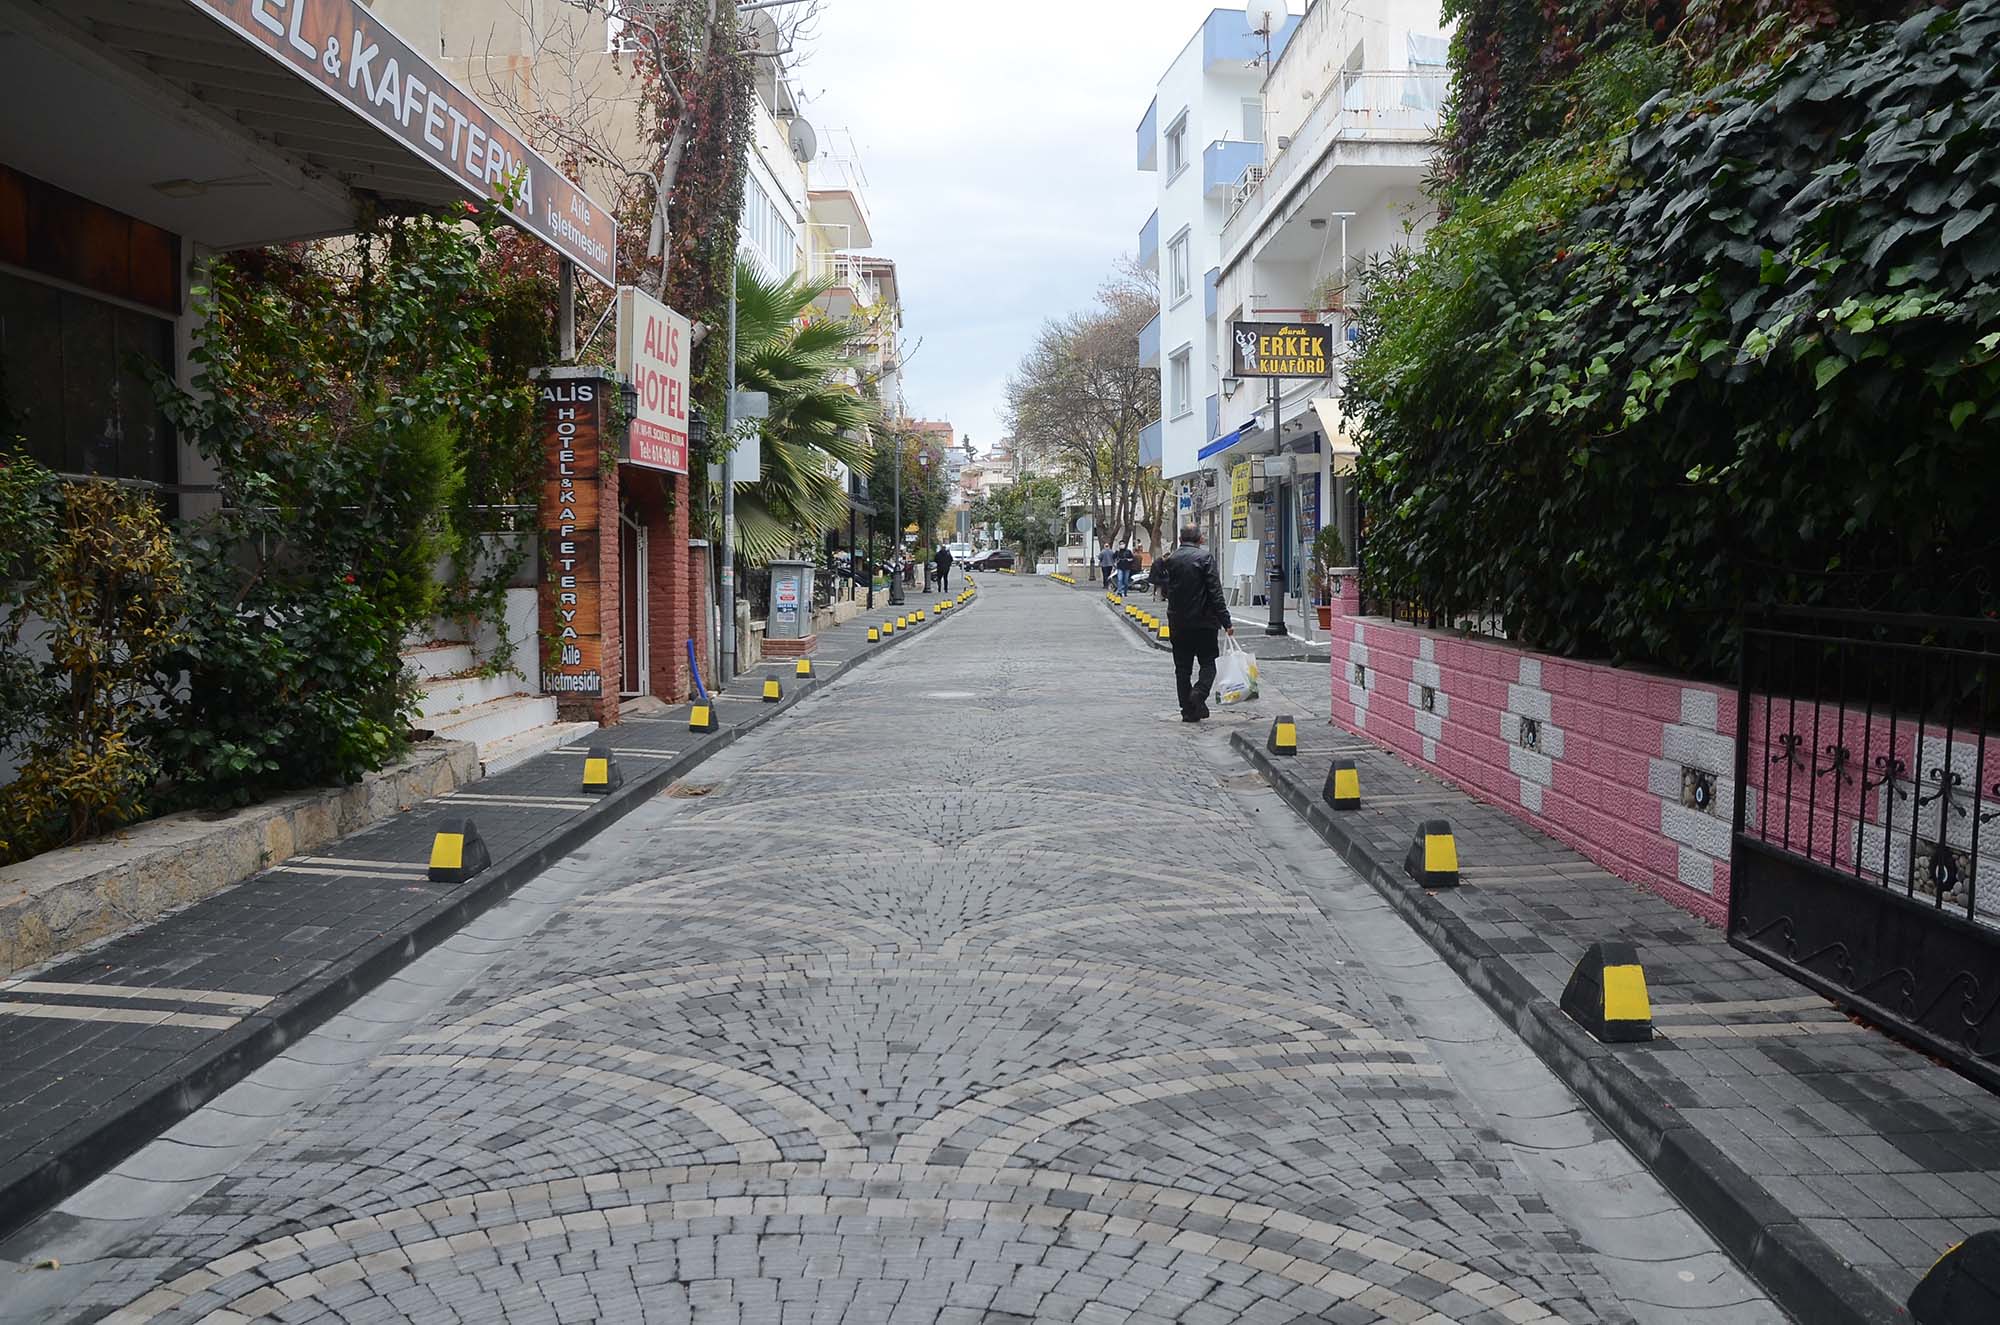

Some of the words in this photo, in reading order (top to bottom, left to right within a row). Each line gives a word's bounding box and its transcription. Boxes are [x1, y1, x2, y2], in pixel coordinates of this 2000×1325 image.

[323, 36, 341, 78] &
[348, 30, 534, 216] KAFETERYA
[571, 194, 591, 226] Aile
[644, 315, 679, 368] ALİS
[1259, 336, 1324, 356] ERKEK
[1260, 357, 1326, 374] KUAFÖRÜ
[540, 382, 593, 402] ALİS
[635, 363, 685, 420] HOTEL
[561, 645, 580, 665] Aile
